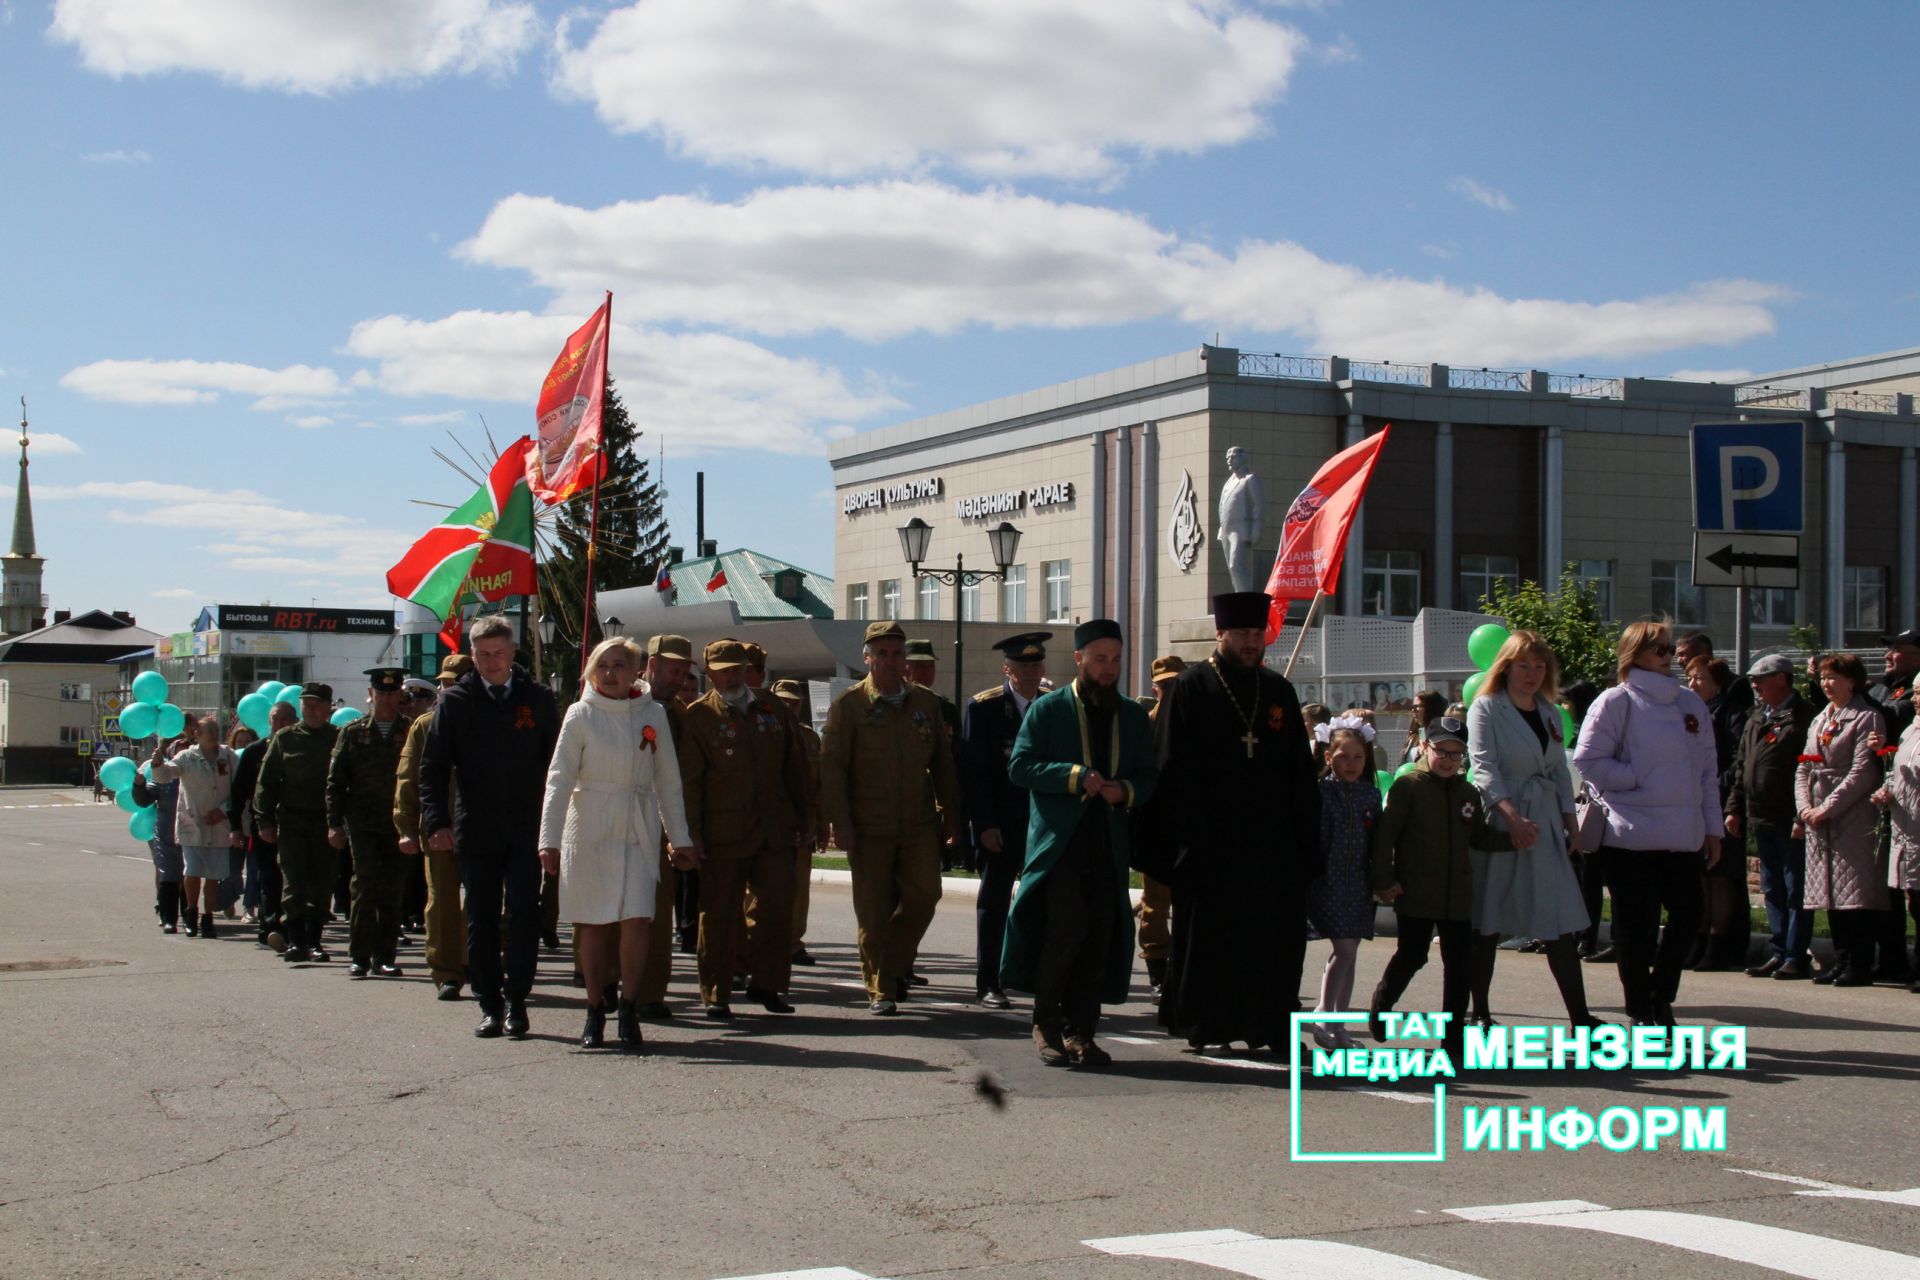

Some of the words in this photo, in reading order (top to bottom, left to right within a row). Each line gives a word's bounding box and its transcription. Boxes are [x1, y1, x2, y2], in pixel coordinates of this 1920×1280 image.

[844, 488, 881, 514] ДВОРЕЦ
[884, 477, 939, 503] КУЛЬТУРЫ
[956, 490, 1022, 519] МӘДӘНИЯТ
[1027, 481, 1069, 507] САРАЕ
[1719, 446, 1780, 530] P
[225, 613, 269, 622] БЫТОВАЯ
[274, 611, 337, 630] RBT.ru
[346, 617, 387, 626] ТЕХНИКА
